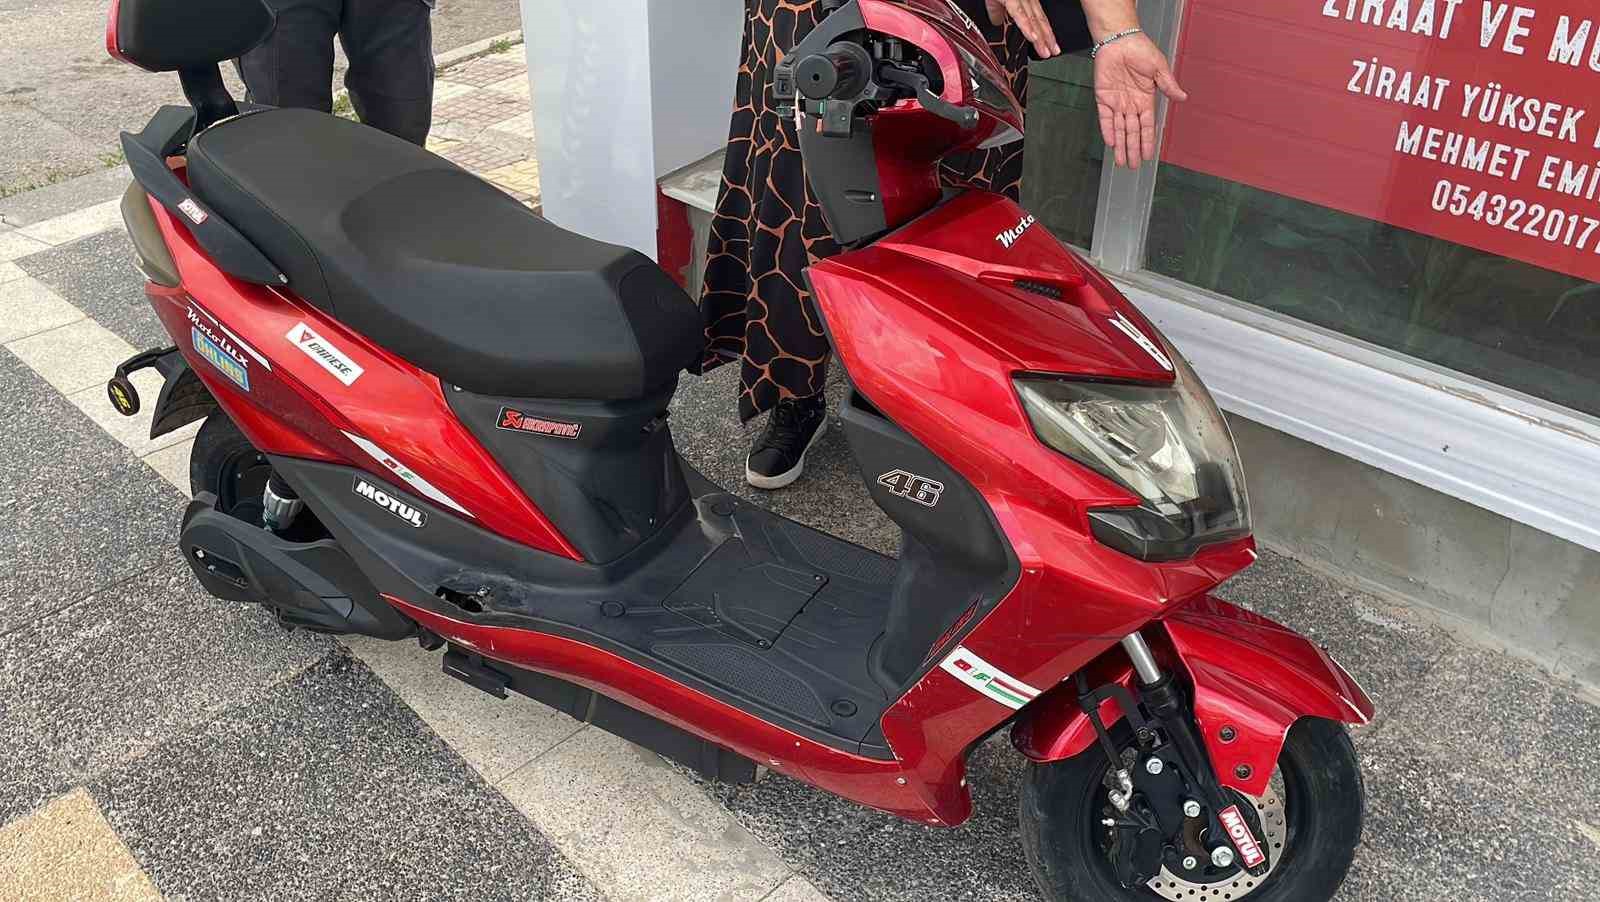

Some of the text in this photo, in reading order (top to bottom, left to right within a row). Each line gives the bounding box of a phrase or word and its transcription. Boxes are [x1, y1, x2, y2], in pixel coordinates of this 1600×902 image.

[1480, 0, 1535, 55] VE
[1347, 57, 1450, 111] ZİRAAT
[1461, 82, 1585, 142] YÜKSEK
[1395, 121, 1530, 180] MEHMET
[1432, 180, 1600, 254] 054322017
[356, 481, 422, 527] MOTUL
[877, 468, 944, 508] 46
[1221, 811, 1261, 864] MOTUL
